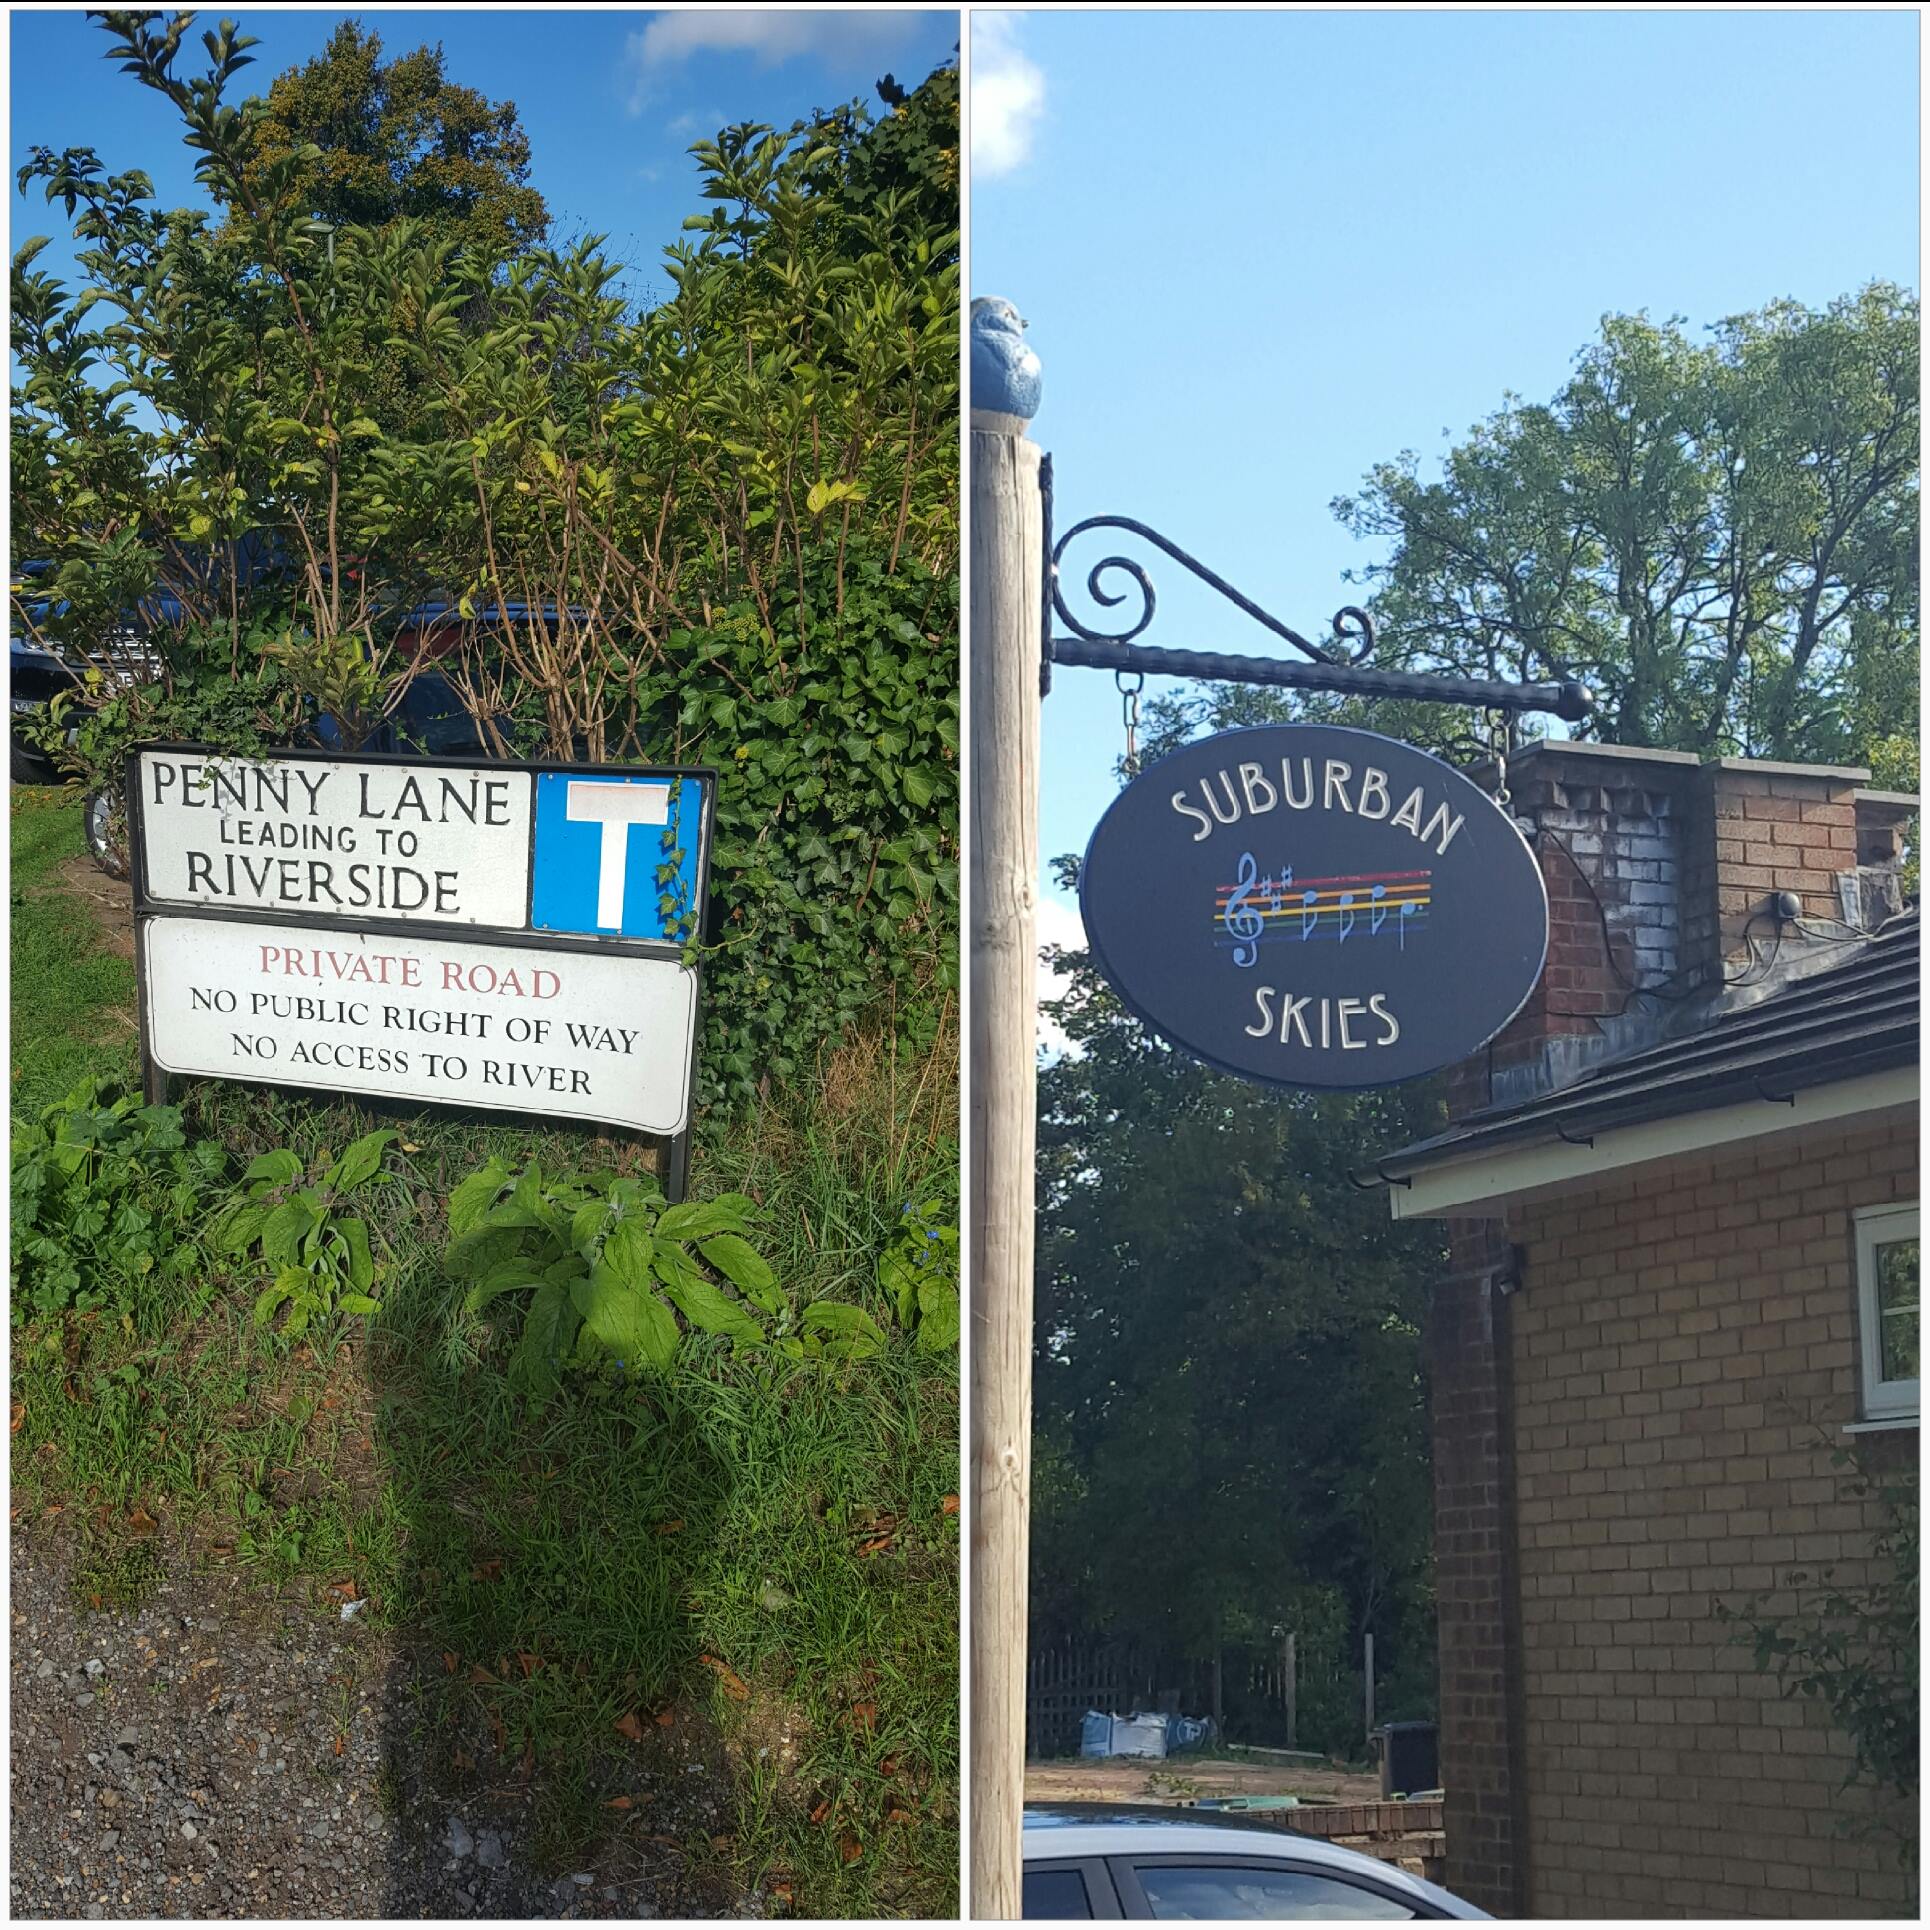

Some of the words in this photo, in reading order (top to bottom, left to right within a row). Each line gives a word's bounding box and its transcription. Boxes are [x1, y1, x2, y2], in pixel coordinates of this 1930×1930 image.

[152, 761, 330, 816] PENNY
[359, 773, 512, 826] LANE
[1171, 757, 1465, 855] SUBURBAN
[220, 819, 358, 853] LEADING
[376, 829, 419, 858] TO
[187, 851, 461, 915] RIVERSIDE
[259, 945, 422, 987] PRIVATE
[442, 962, 562, 999] ROAD
[189, 987, 238, 1014] NO
[251, 991, 371, 1026] PUBLIC
[383, 1006, 493, 1039] RIGHT
[506, 1017, 552, 1045] OF
[565, 1022, 641, 1055] WAY
[1244, 986, 1400, 1049] SKIES
[231, 1032, 278, 1060] NO
[290, 1040, 409, 1074] ACCESS
[421, 1053, 467, 1080] TO
[482, 1060, 593, 1095] RIVER
